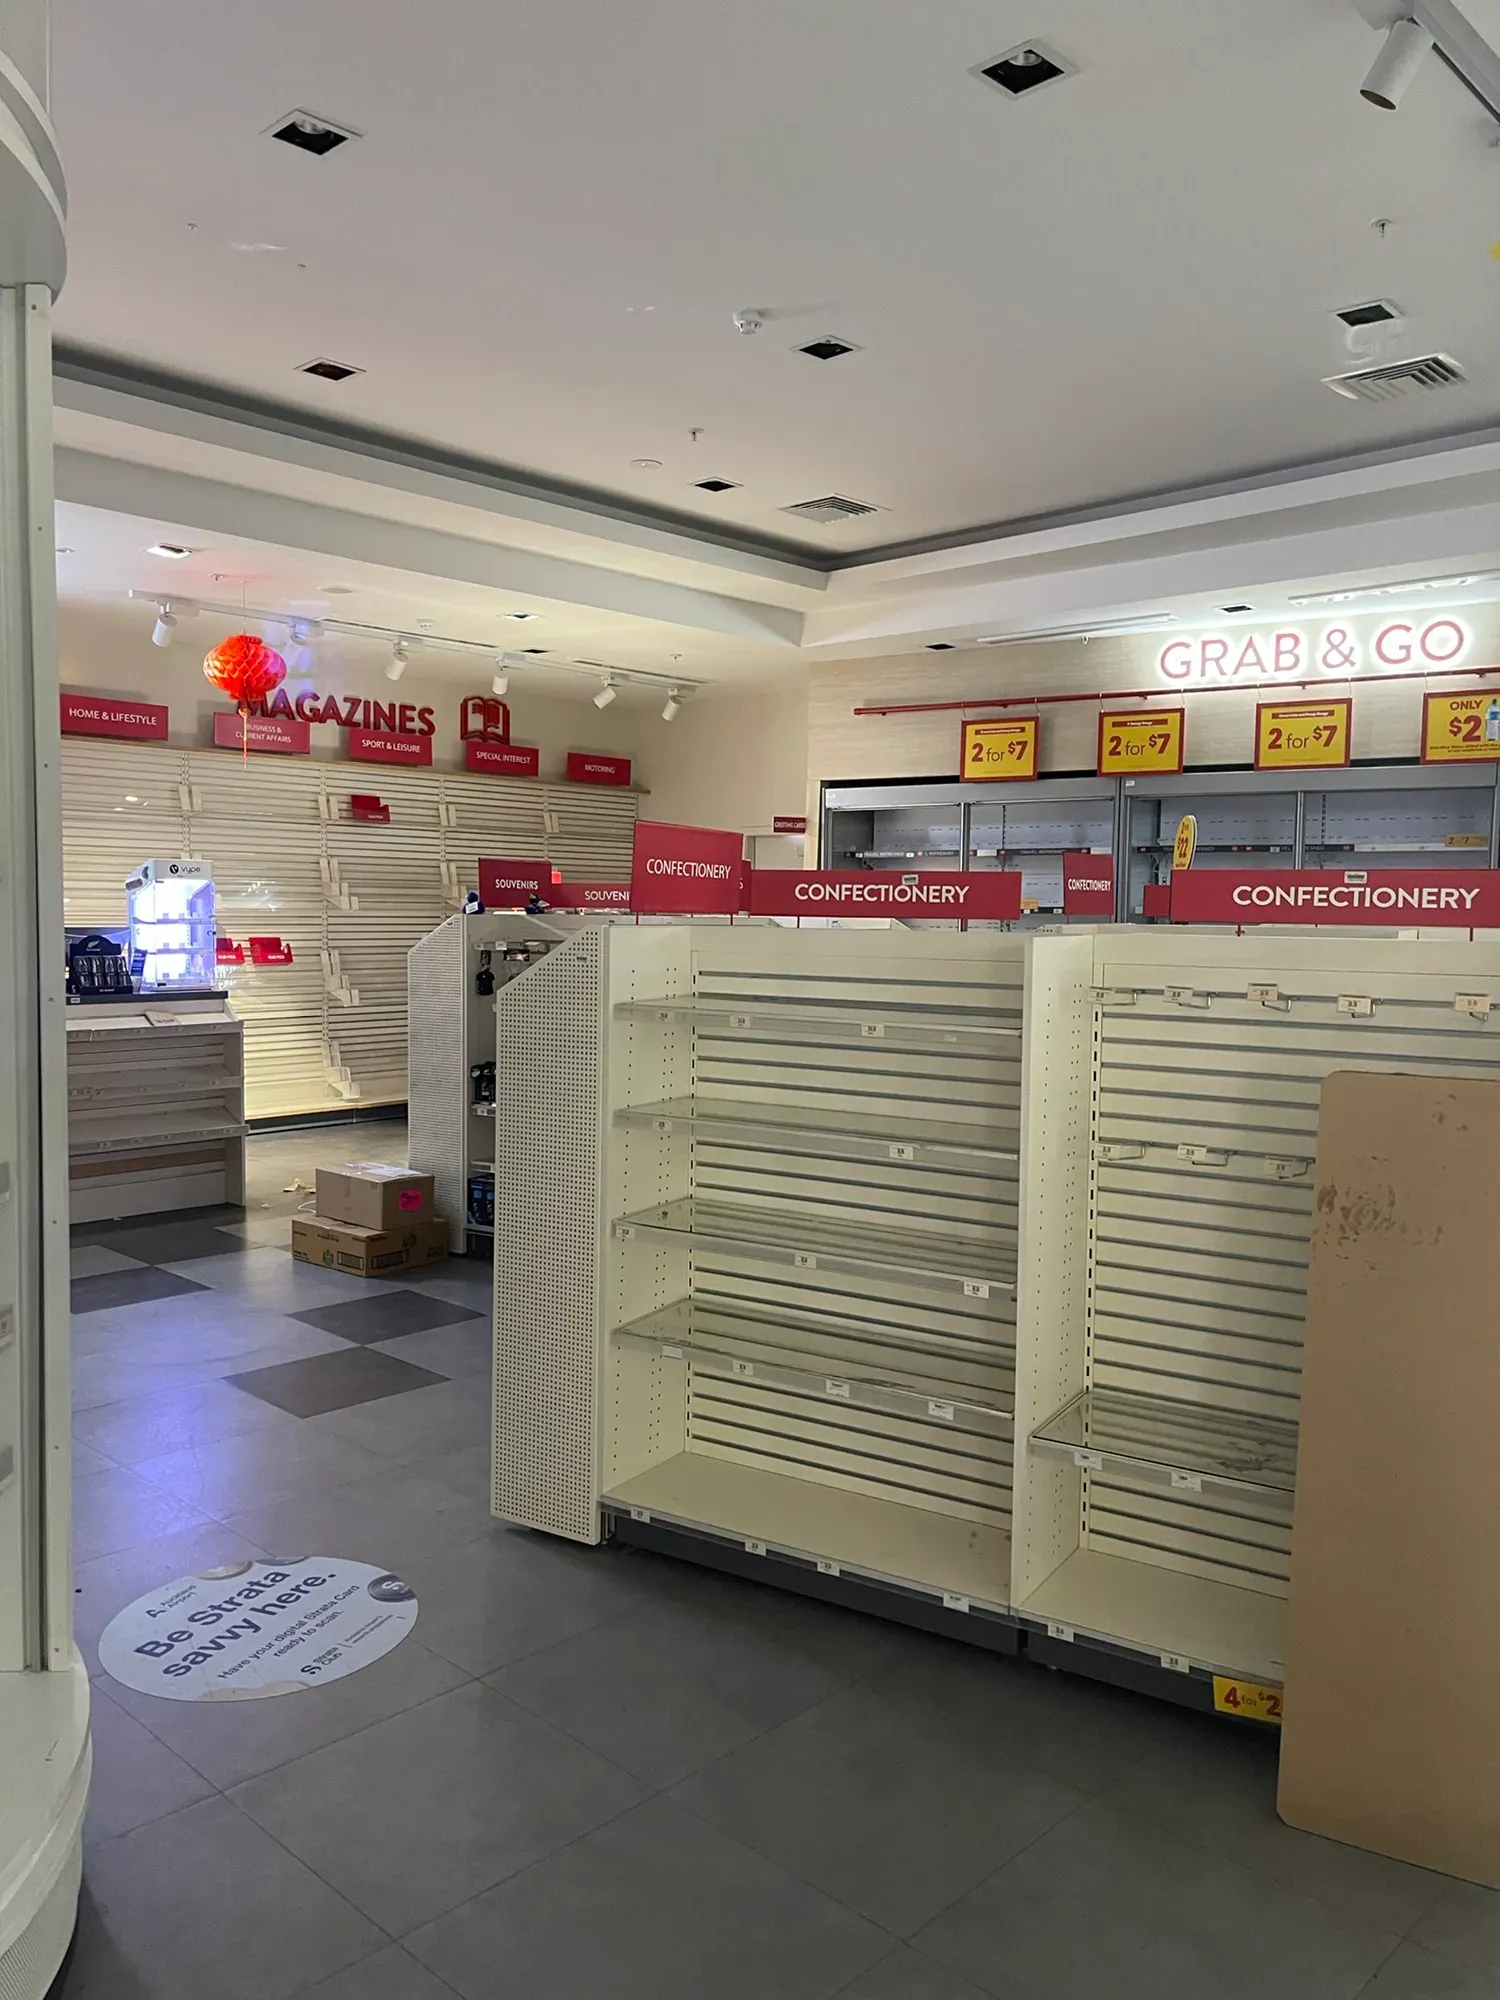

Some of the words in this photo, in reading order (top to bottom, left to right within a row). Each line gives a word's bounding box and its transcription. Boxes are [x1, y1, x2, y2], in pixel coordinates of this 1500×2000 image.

[1160, 633, 1301, 680] GRAB
[1322, 628, 1356, 669] &
[1375, 620, 1465, 665] GO
[1449, 700, 1483, 711] ONLY
[69, 708, 100, 719] HOME
[101, 711, 109, 720] &
[110, 713, 157, 726] LIFESTYLE
[265, 734, 292, 743] AFFAIRS
[1267, 727, 1282, 750] 2
[1286, 733, 1309, 749] for
[1312, 725, 1338, 748] $7
[1448, 714, 1482, 743] $2
[361, 739, 385, 750] SPORT
[386, 742, 393, 751] &
[393, 743, 421, 753] LEISURE
[971, 743, 984, 763] 2
[986, 747, 1006, 762] for
[1007, 740, 1029, 761] $7
[1108, 735, 1122, 757] 2
[1125, 740, 1146, 756] for
[1148, 733, 1171, 755] $7
[476, 751, 501, 762] SPECIAL
[502, 754, 532, 764] INTEREST
[584, 764, 616, 774] MOTORING
[646, 858, 732, 880] CONFECTIONERY
[495, 878, 539, 891] SOUVENIRS
[795, 883, 970, 904] CONFECTIONERY
[1067, 878, 1112, 891] CONFECTIONERY
[584, 890, 630, 902] SOUVENI
[1232, 885, 1481, 910] CONFECTIONERY
[134, 1630, 194, 1658] Be
[187, 1571, 291, 1626] Strata
[162, 1617, 262, 1677] savvy
[249, 1573, 336, 1616] here.
[217, 1659, 251, 1679] Have
[248, 1642, 275, 1660] your
[275, 1620, 308, 1642] digital
[304, 1601, 338, 1620] Strata
[334, 1585, 360, 1601] Card
[273, 1636, 306, 1658] ready
[301, 1628, 317, 1637] to
[315, 1610, 344, 1628] scan.
[1224, 1686, 1241, 1708] 4
[1241, 1694, 1257, 1707] for
